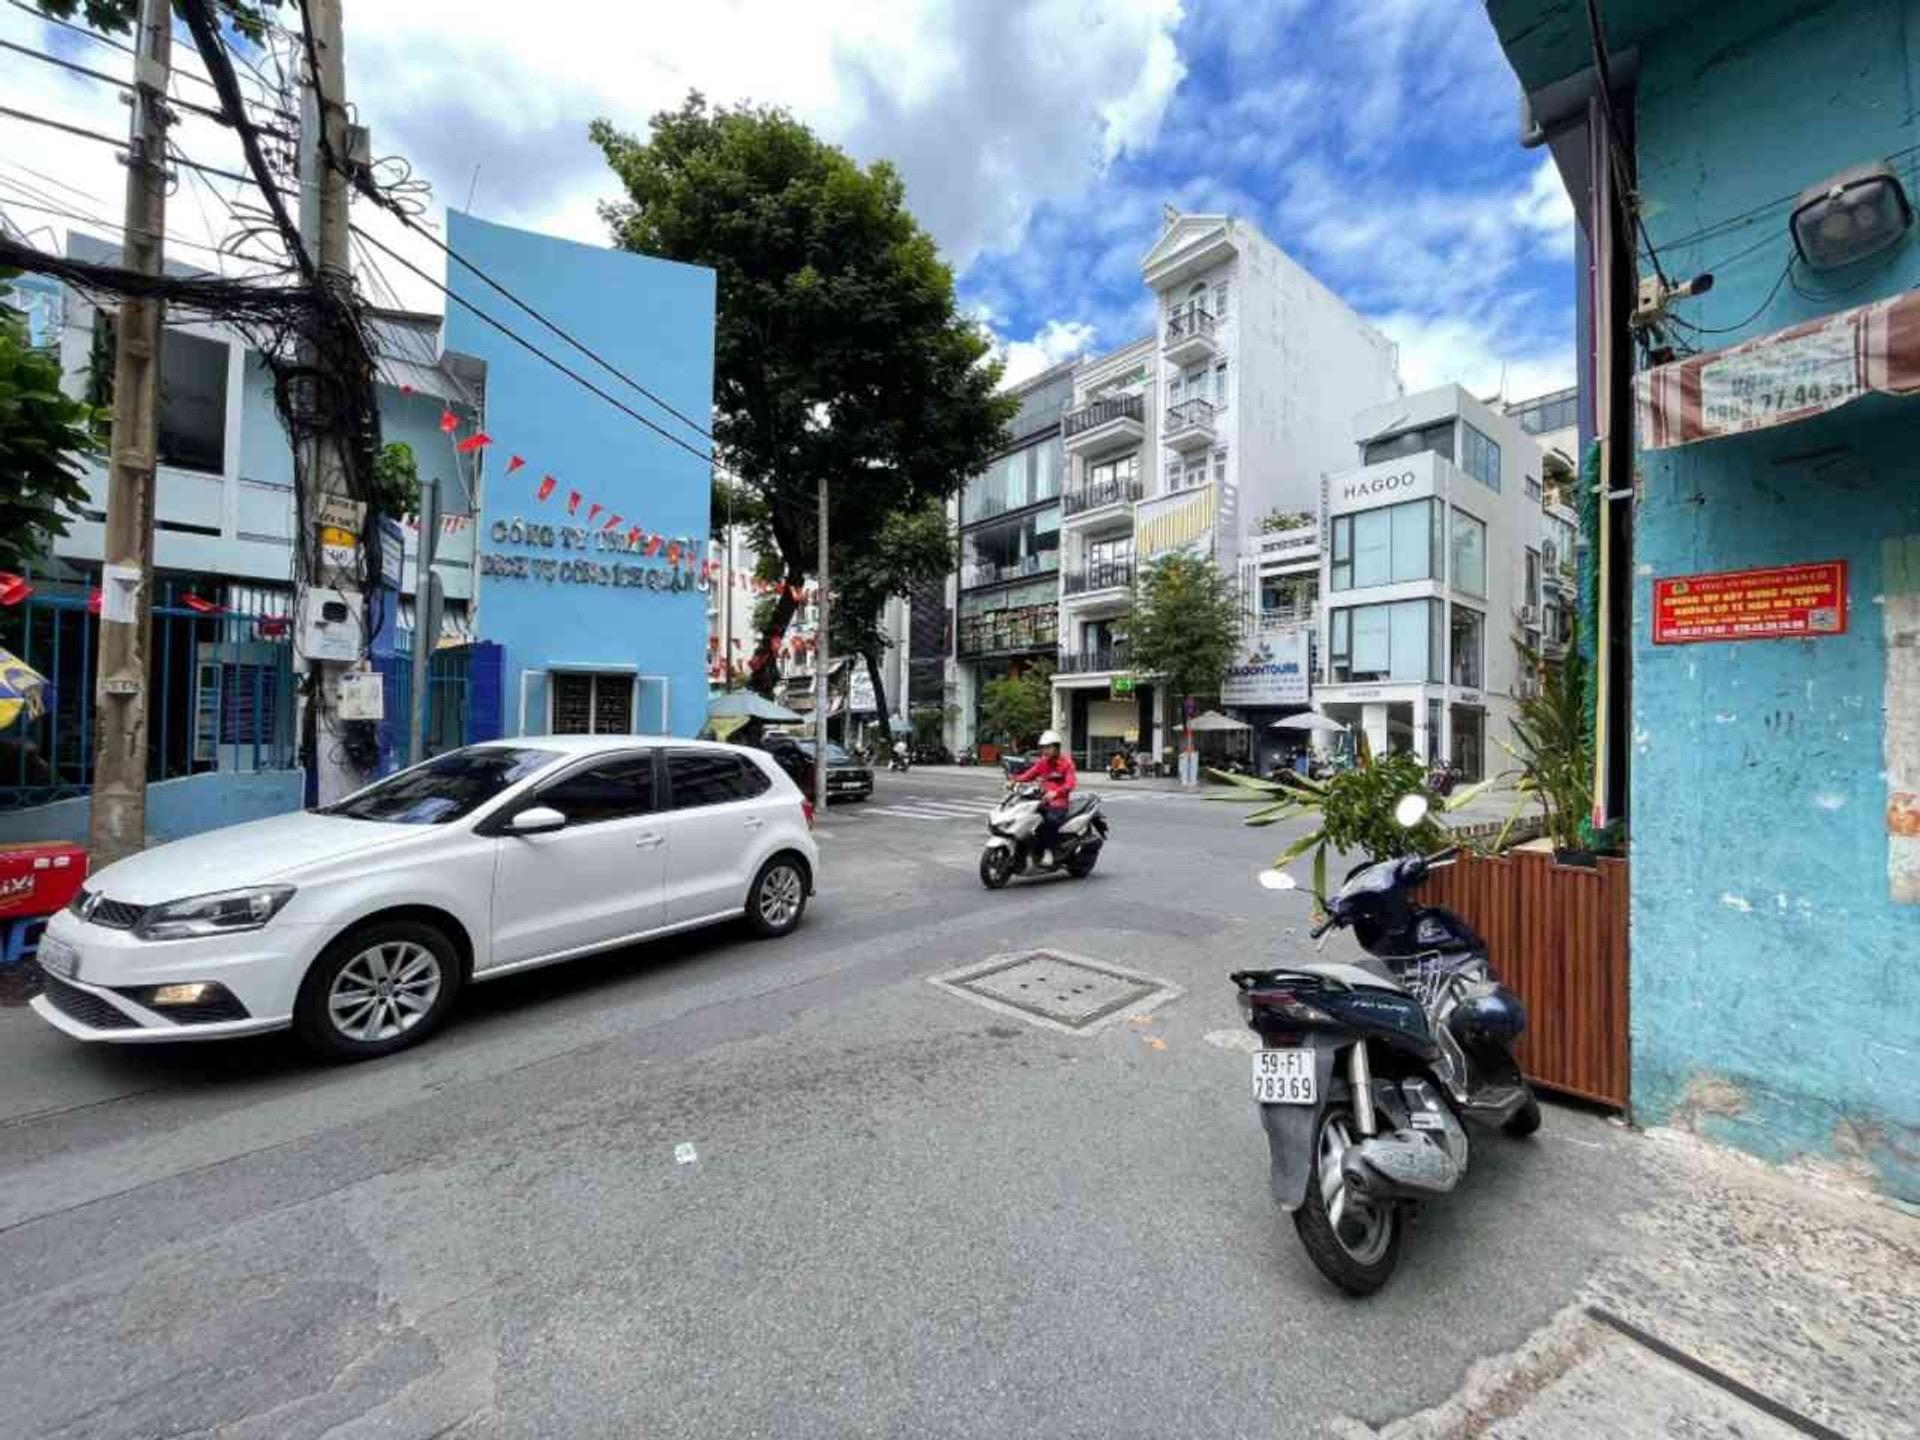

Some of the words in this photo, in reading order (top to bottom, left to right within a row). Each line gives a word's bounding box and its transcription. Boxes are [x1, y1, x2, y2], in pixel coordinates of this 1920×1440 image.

[1343, 471, 1415, 500] HAGOO
[491, 516, 554, 547] CÔNG
[1261, 1054, 1303, 1075] 59-F1
